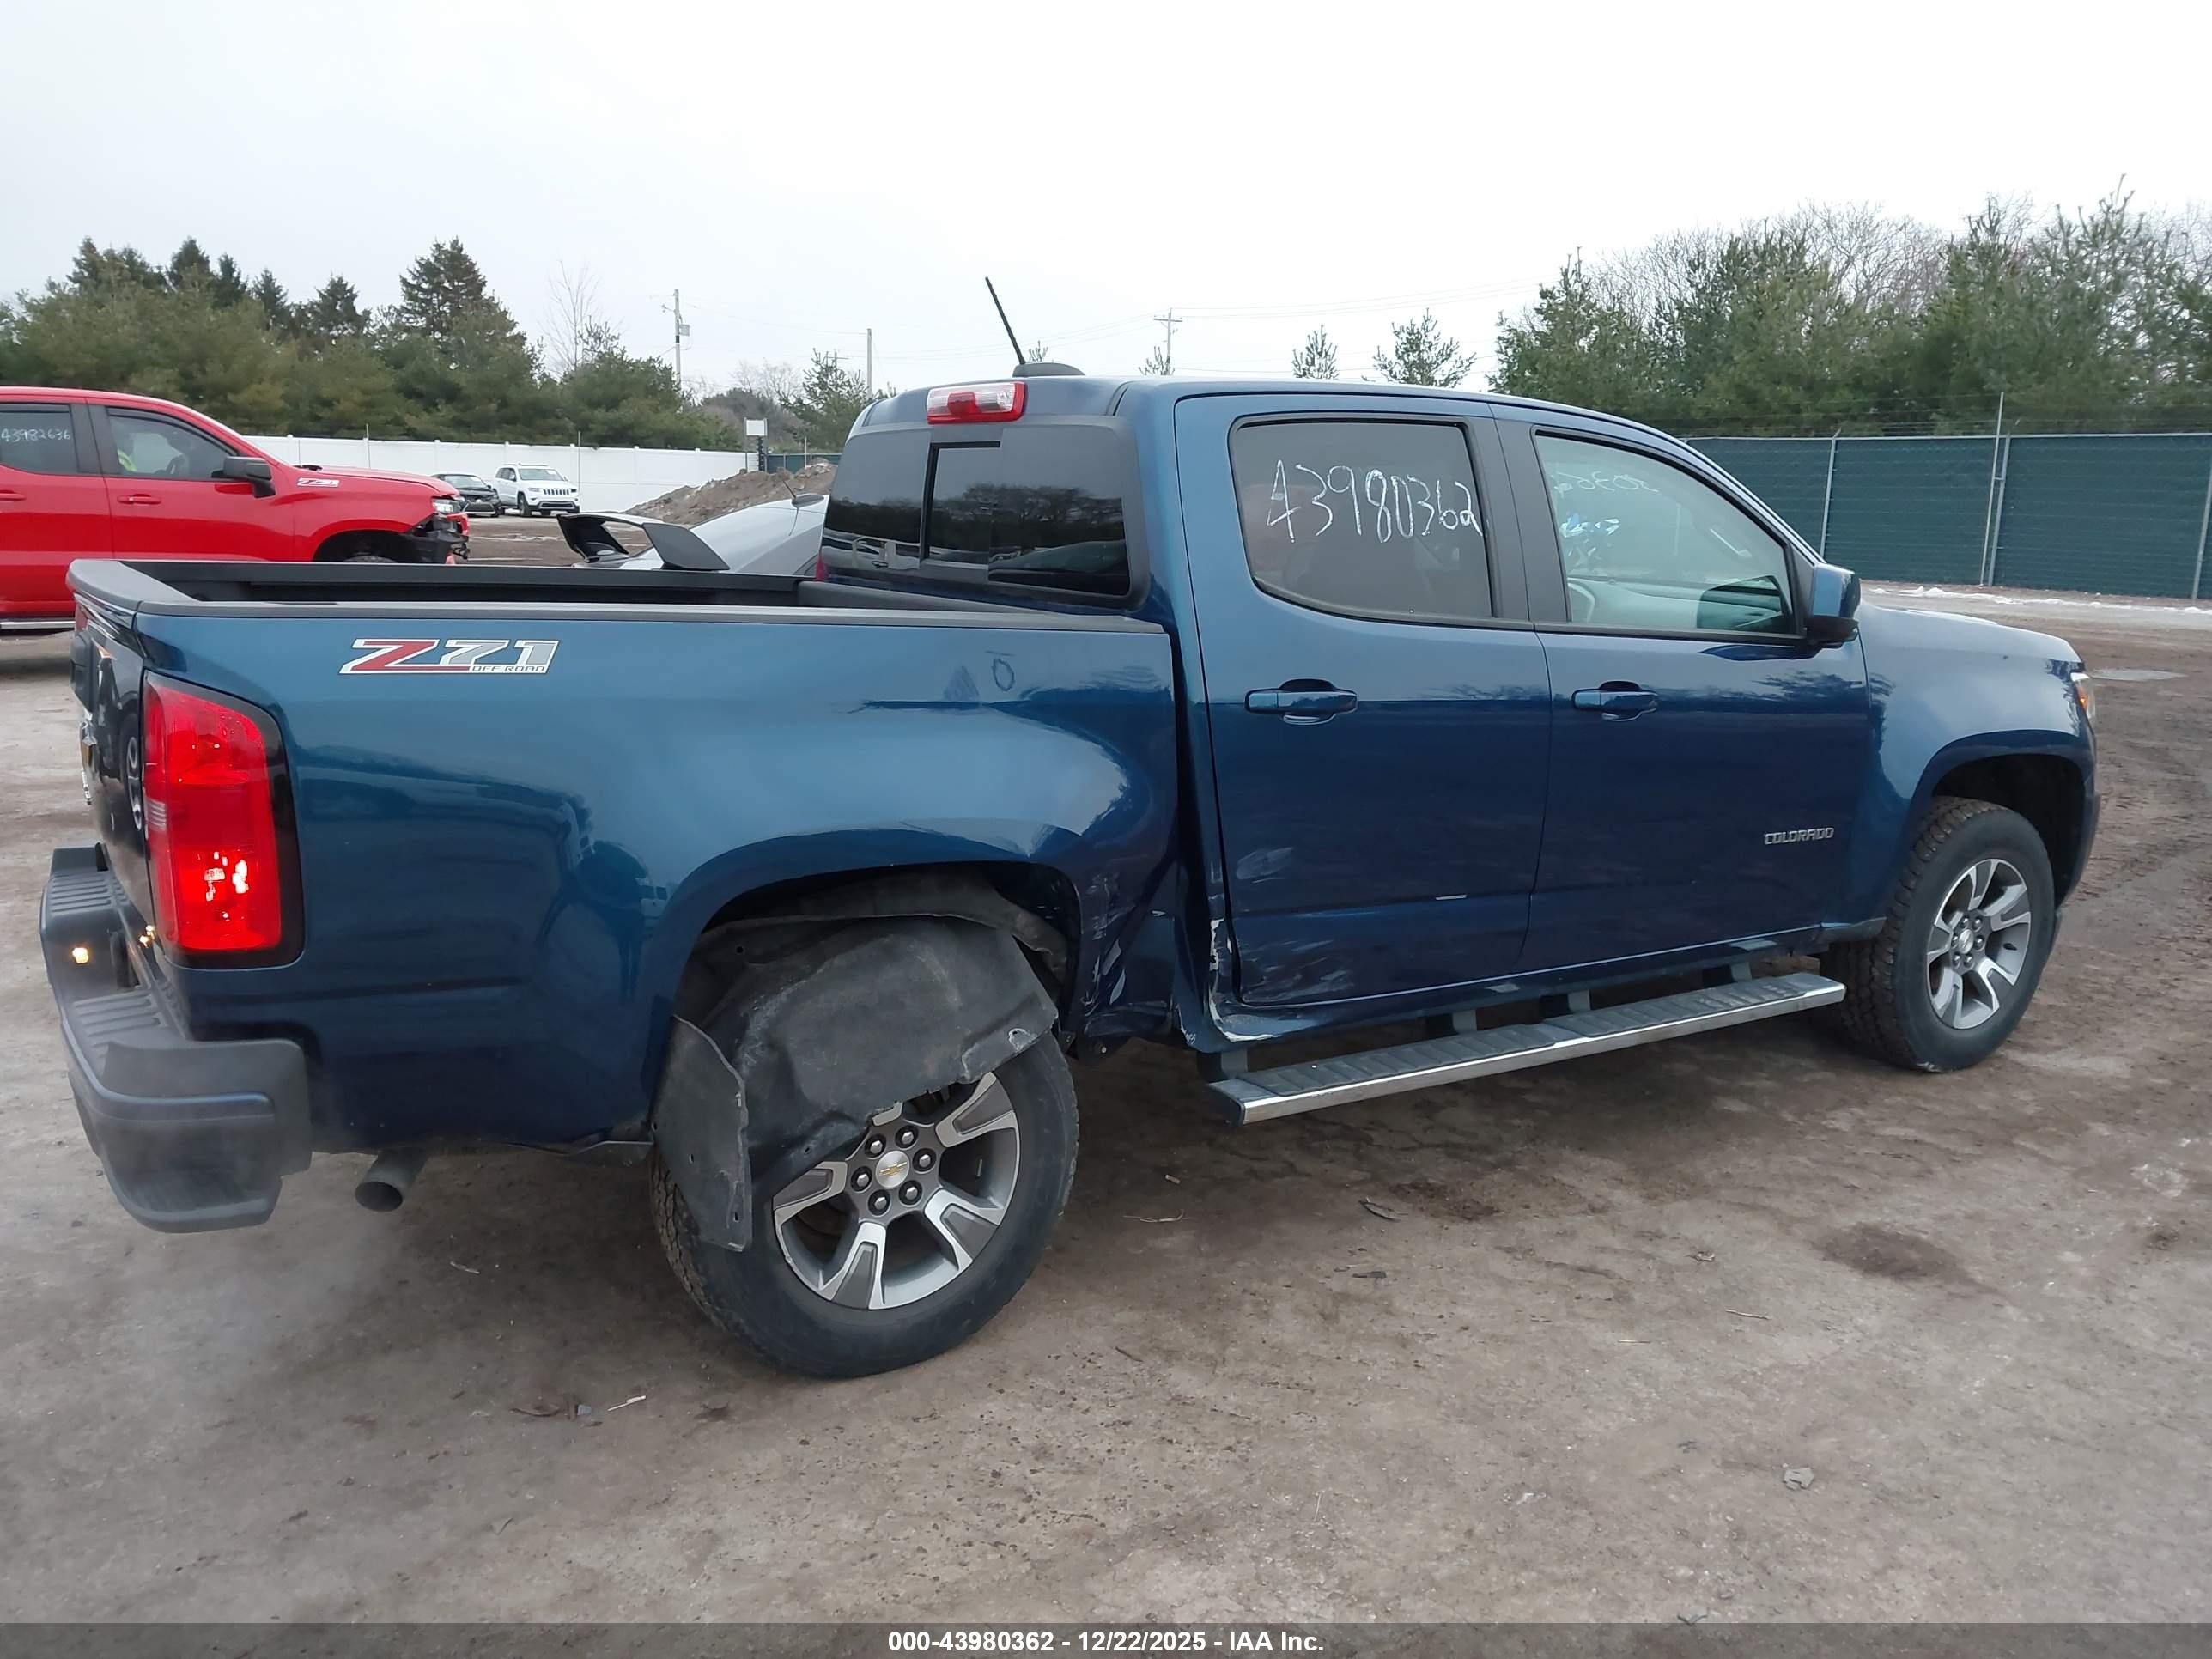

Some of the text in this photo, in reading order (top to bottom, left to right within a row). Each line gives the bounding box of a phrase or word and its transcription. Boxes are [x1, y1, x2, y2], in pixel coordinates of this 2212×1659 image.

[1267, 459, 1483, 543] 43980362
[339, 639, 559, 674] Z71
[1764, 827, 1835, 845] COLORADO
